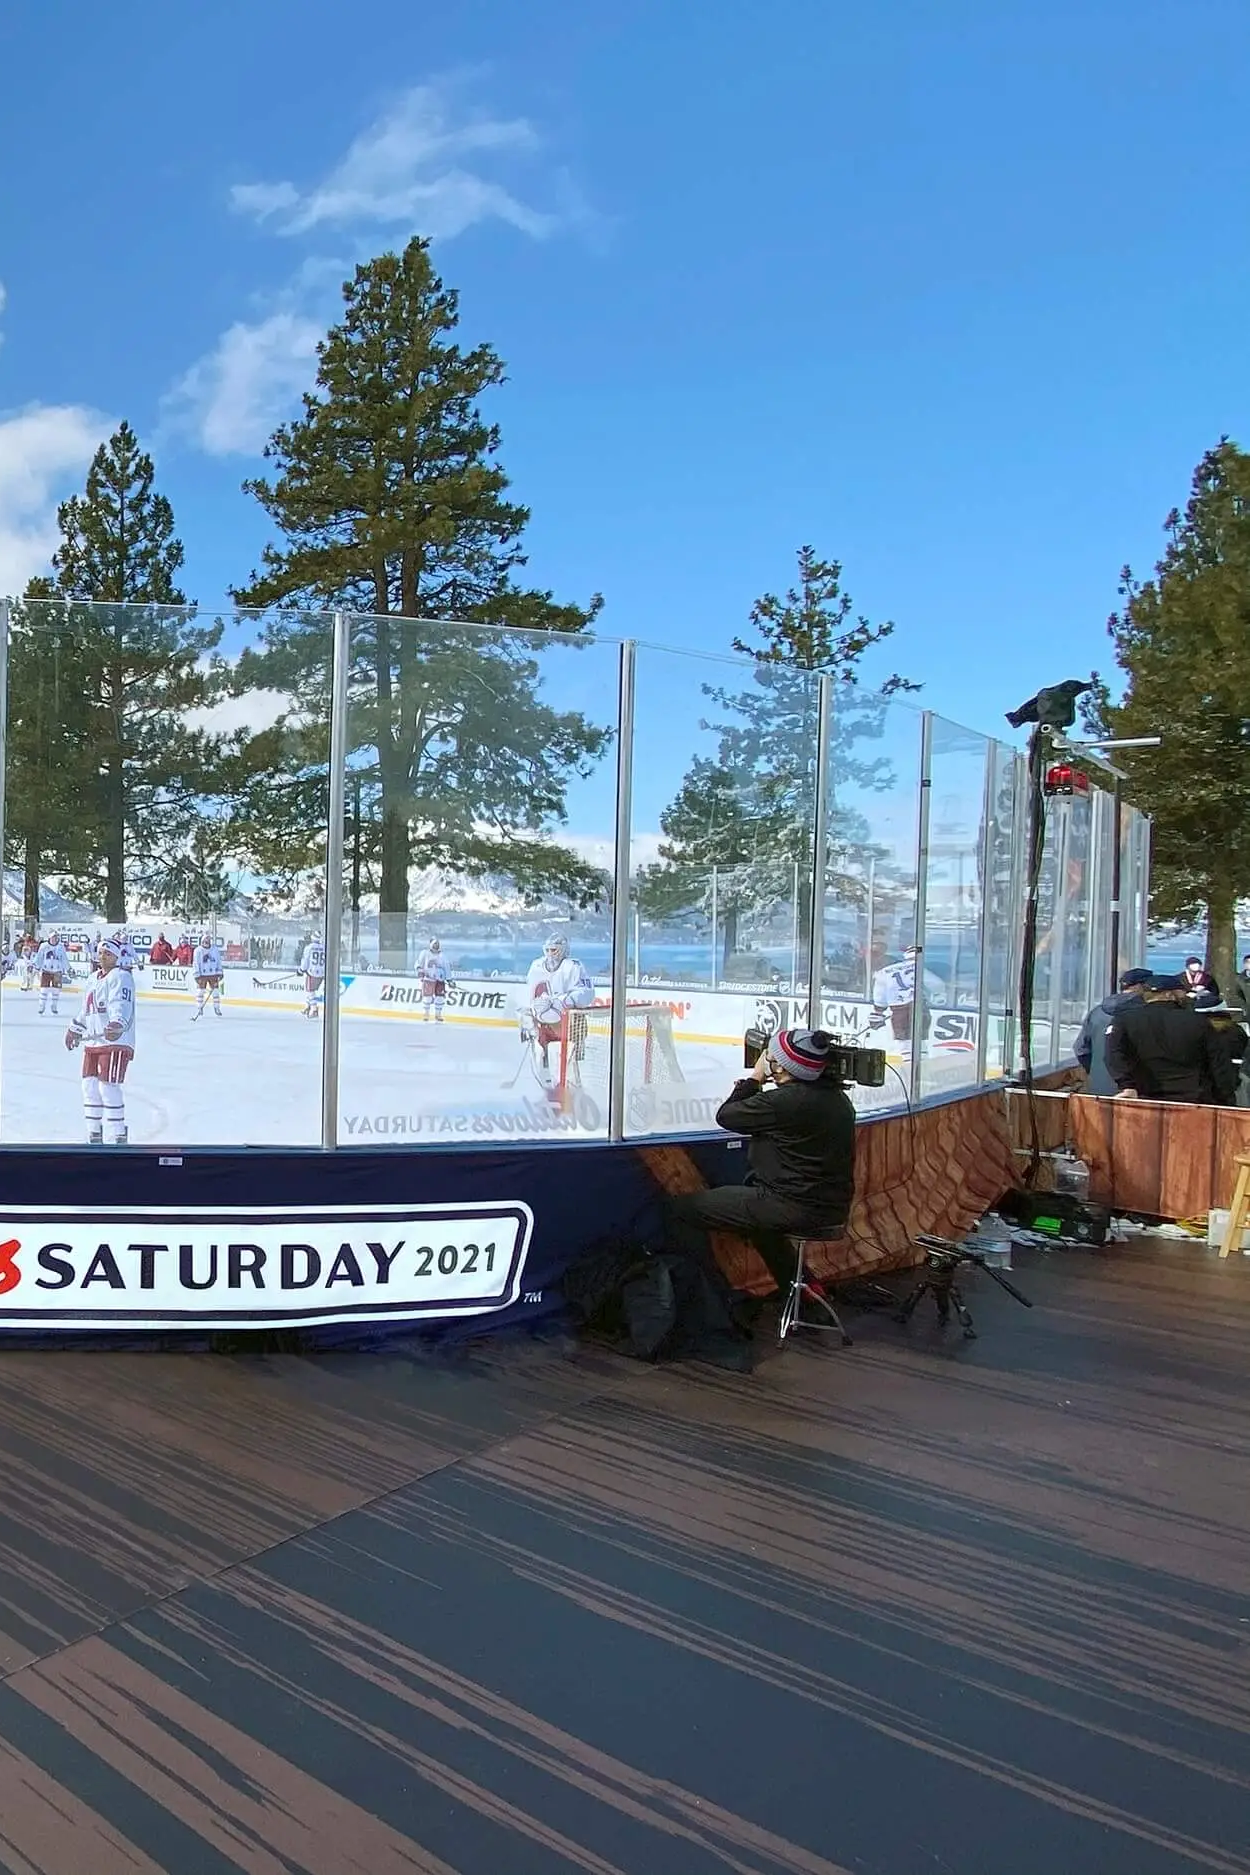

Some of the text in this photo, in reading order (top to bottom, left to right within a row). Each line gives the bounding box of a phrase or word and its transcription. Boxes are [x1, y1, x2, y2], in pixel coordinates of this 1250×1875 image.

[152, 968, 189, 981] TRULY
[381, 984, 507, 1008] BRIDSTONE
[35, 1240, 406, 1290] SATURDAY
[414, 1242, 496, 1277] 2021
